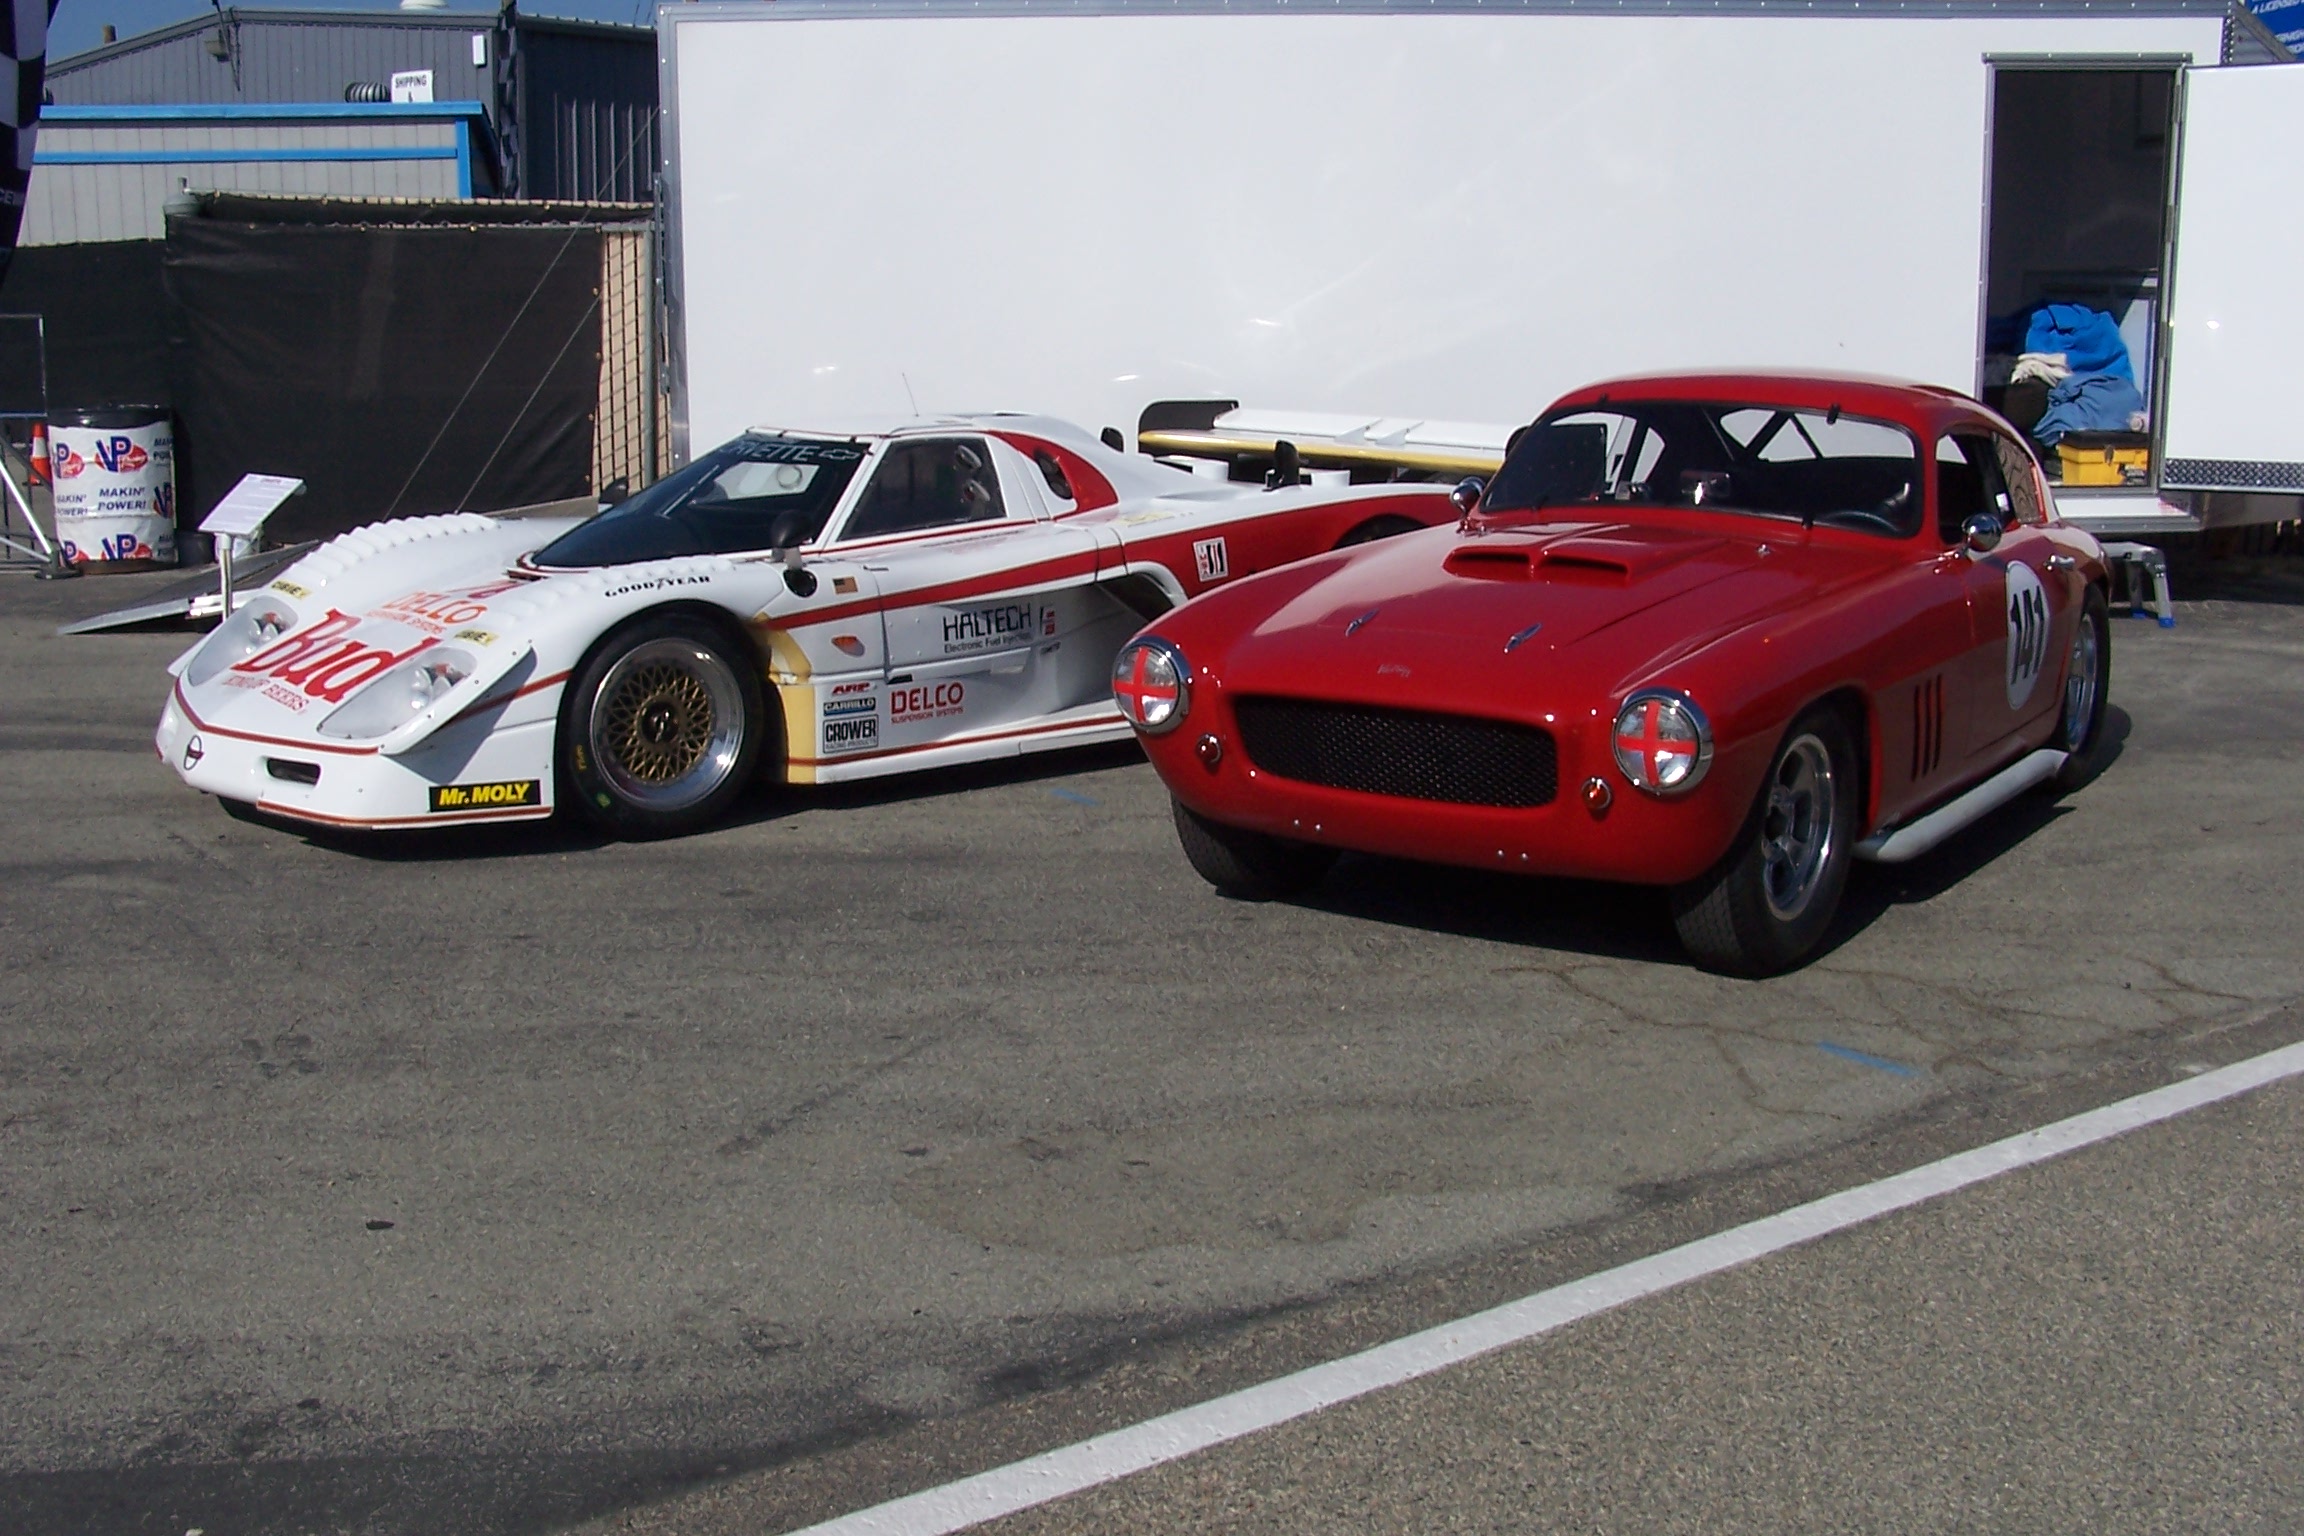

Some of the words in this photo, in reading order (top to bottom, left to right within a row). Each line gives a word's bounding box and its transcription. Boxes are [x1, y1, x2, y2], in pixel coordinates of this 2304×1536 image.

[395, 75, 427, 88] SHIPPING
[96, 436, 132, 472] VP
[99, 487, 146, 497] MAKIN'
[97, 500, 147, 512] POWER!
[604, 576, 711, 597] GOODYEAR
[381, 591, 488, 624] DELCO
[943, 603, 1032, 641] HALTECH
[230, 608, 445, 703] Bud
[944, 641, 983, 653] Electronic
[985, 636, 1001, 648] Fuel
[832, 682, 870, 694] ARP
[891, 682, 964, 714] DELCO
[824, 699, 875, 711] CARRILLO
[825, 719, 876, 742] CROWER
[439, 788, 469, 805] Mr.
[472, 782, 530, 803] MOLY
